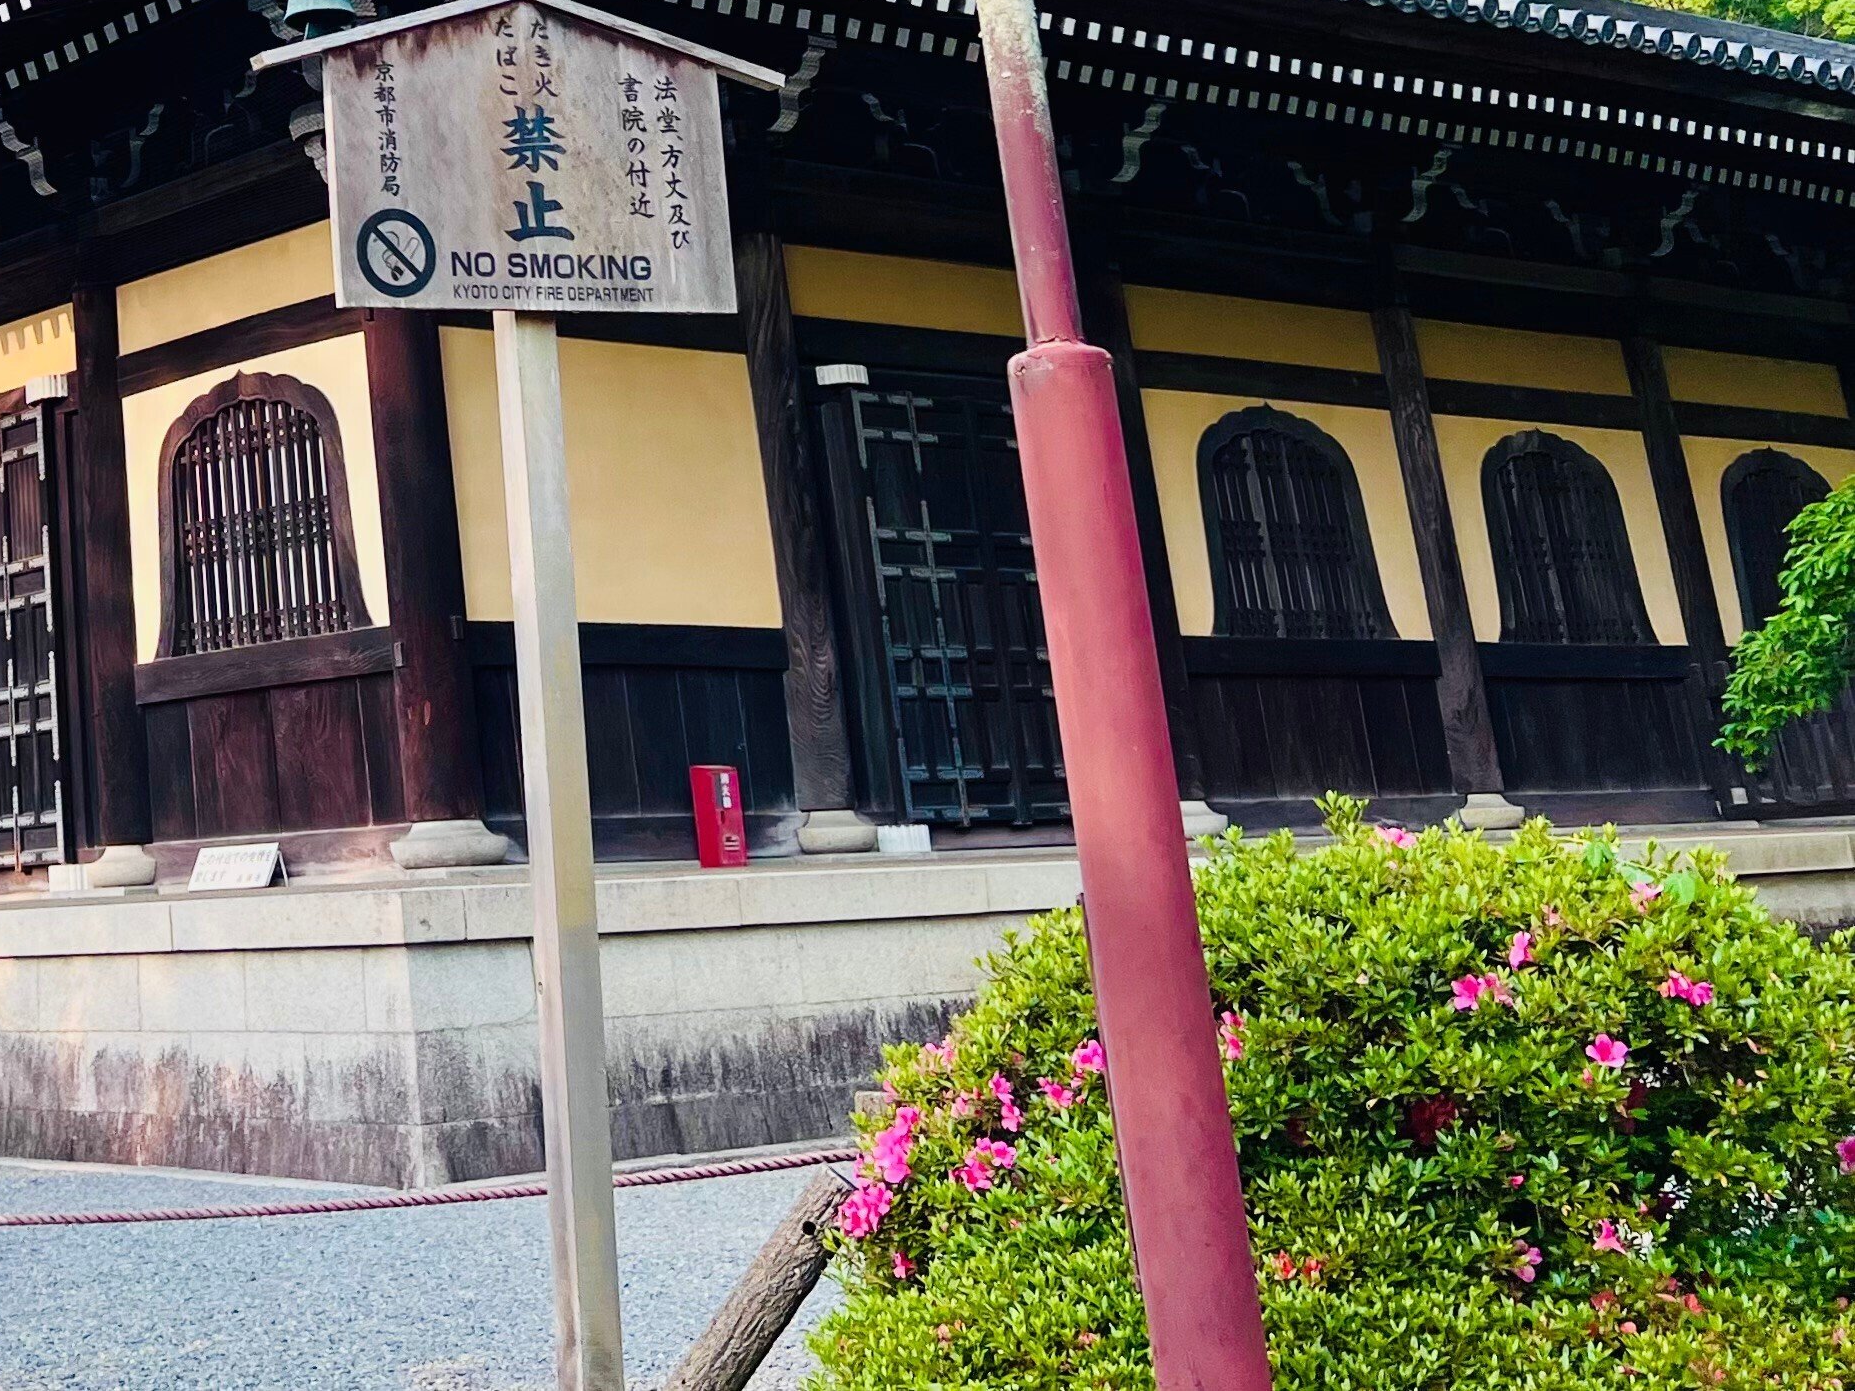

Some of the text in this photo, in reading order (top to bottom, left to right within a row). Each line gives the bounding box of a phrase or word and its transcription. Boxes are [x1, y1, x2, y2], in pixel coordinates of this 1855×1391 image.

[496, 17, 518, 96] たばこ
[531, 18, 559, 97] たき火
[374, 61, 401, 197] 京都市消防局
[618, 73, 654, 219] 書院の付近
[499, 103, 575, 242] 禁止
[451, 251, 652, 281] NO SMOKING
[453, 284, 654, 303] KYOTO CITY FIRE DEPARTMENT
